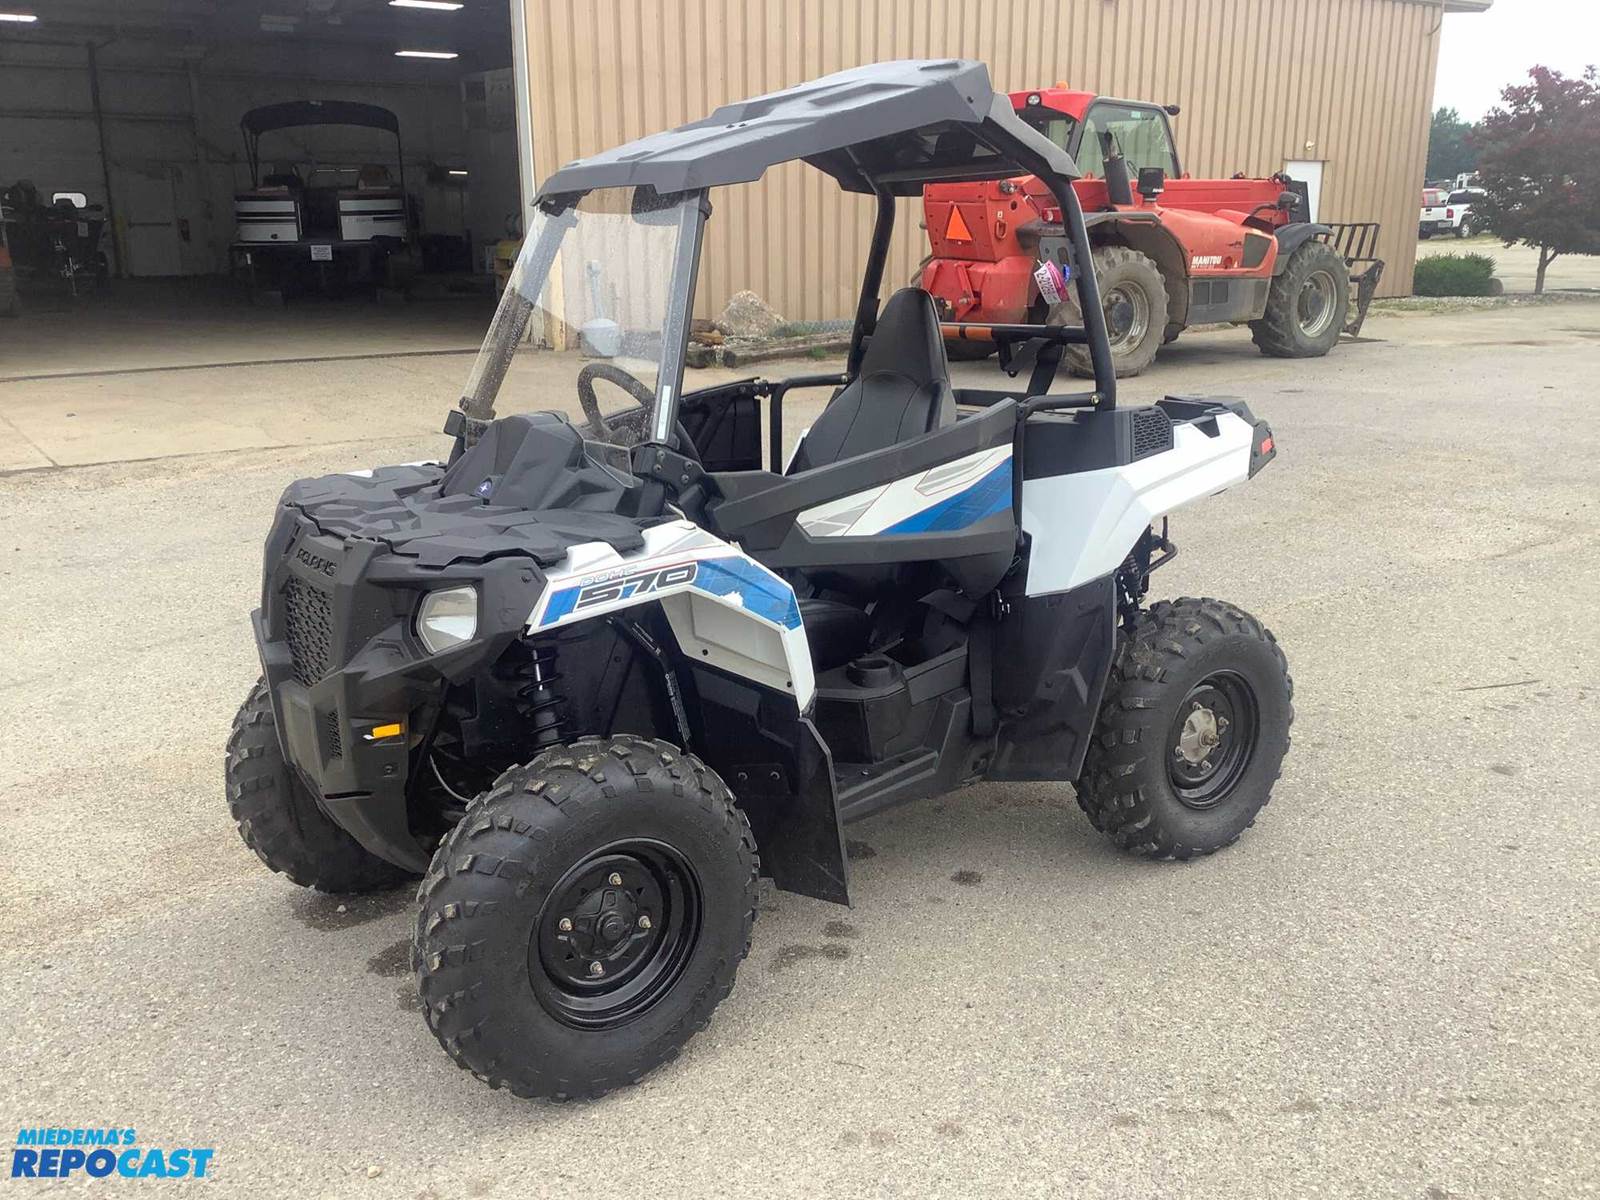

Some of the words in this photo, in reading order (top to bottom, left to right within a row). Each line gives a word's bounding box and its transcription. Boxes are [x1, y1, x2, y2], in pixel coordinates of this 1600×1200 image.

[1191, 256, 1222, 265] MANITOU
[296, 548, 337, 577] POLARIS
[573, 562, 698, 611] 570
